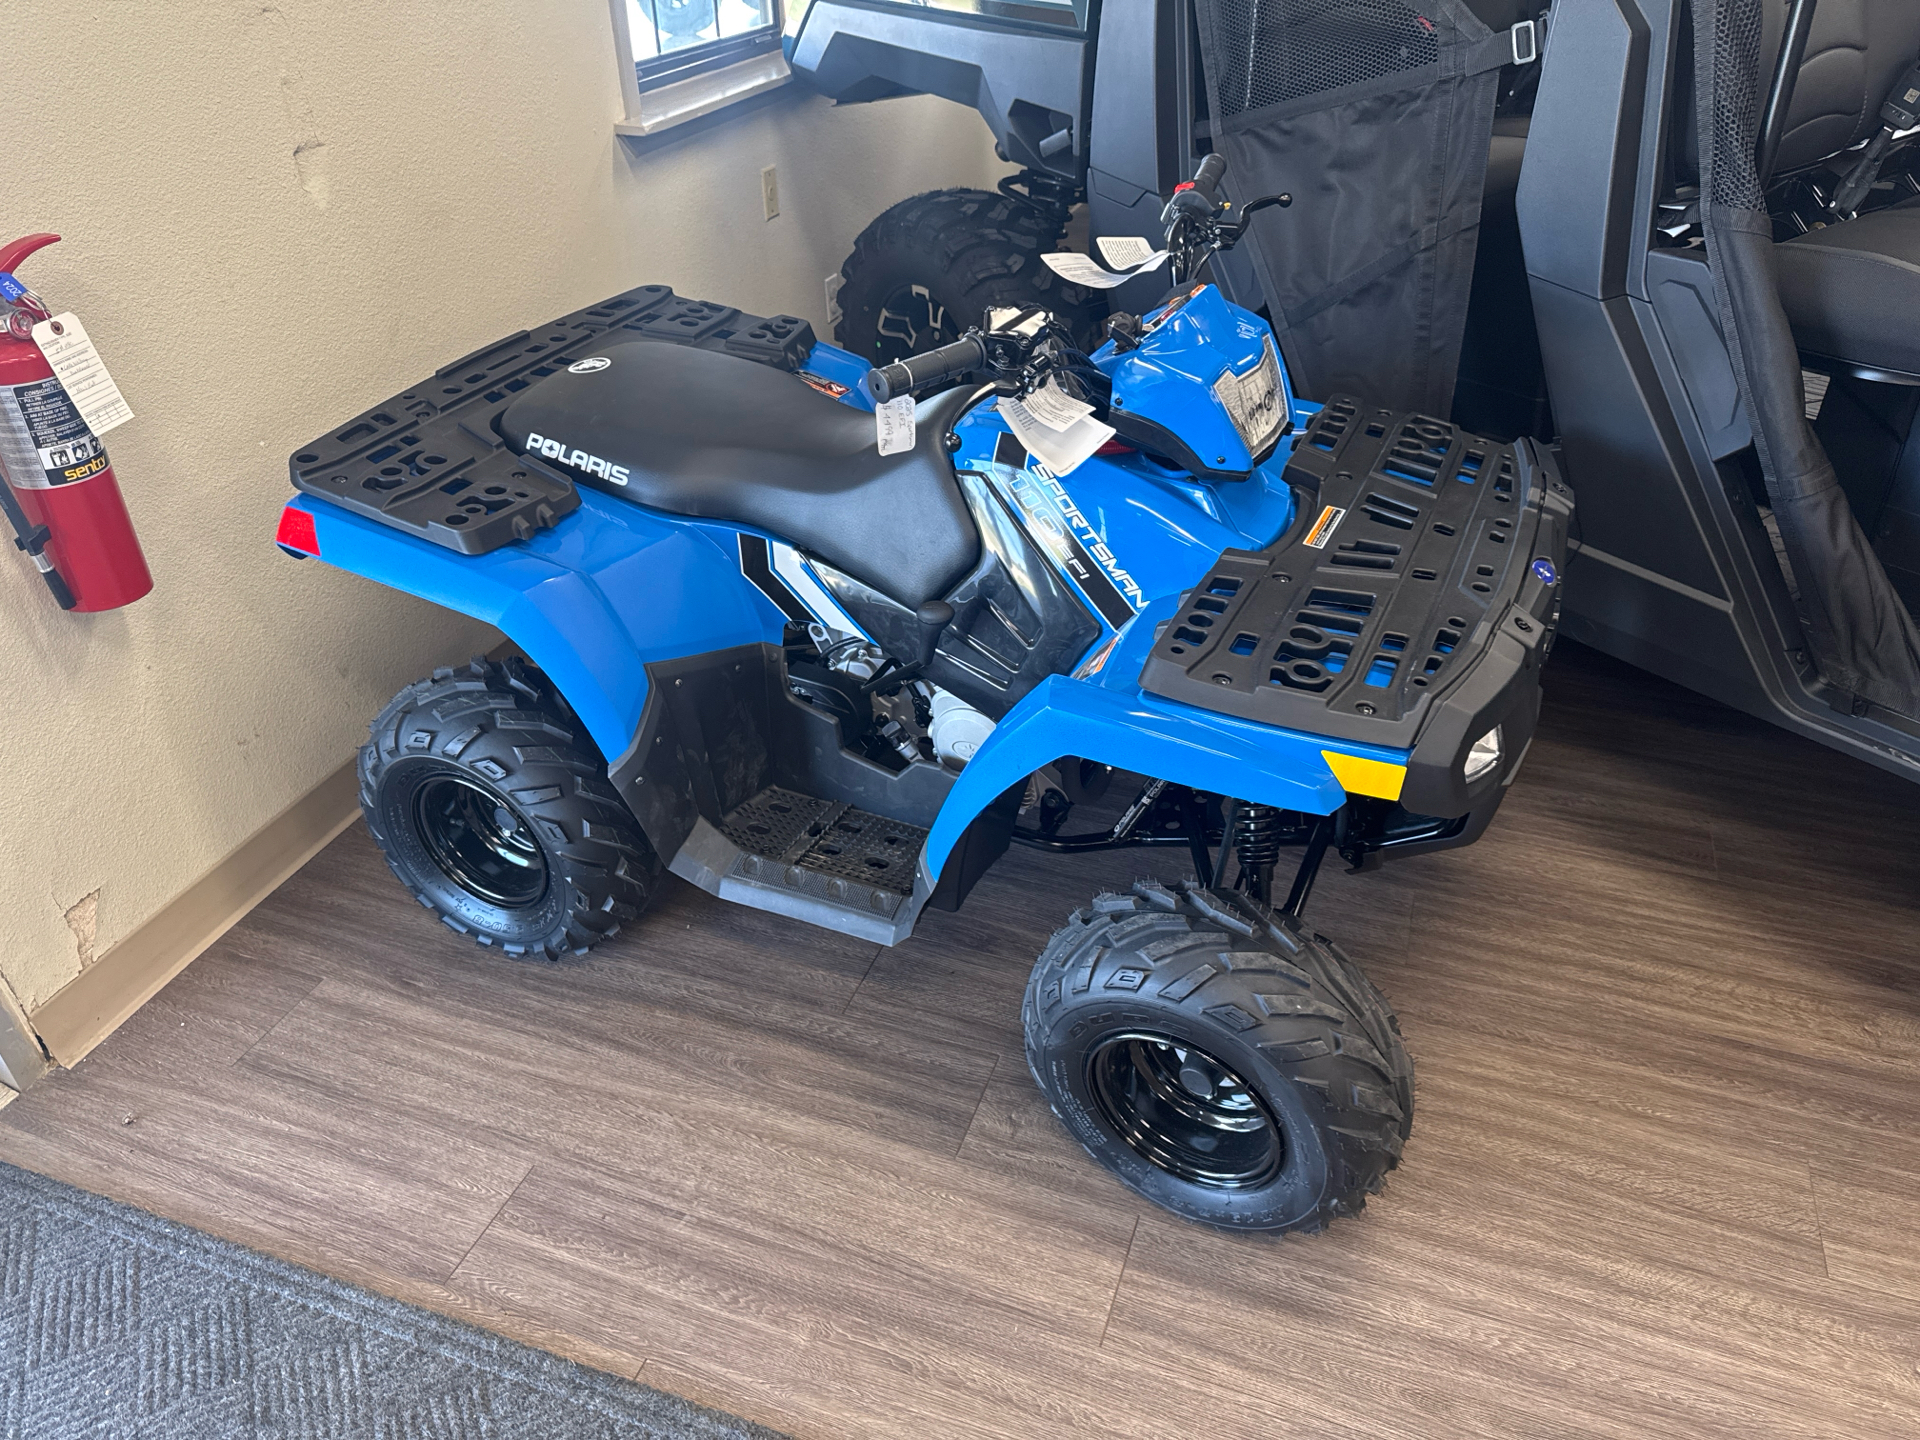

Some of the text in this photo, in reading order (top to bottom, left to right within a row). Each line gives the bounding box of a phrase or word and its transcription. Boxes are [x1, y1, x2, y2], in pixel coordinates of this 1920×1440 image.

[2, 281, 23, 297] 2024
[64, 455, 106, 482] sentry
[525, 432, 631, 487] POLARIS
[1009, 474, 1065, 541] 110
[1056, 543, 1091, 580] EFI
[1031, 462, 1151, 609] SPORTSMAN
